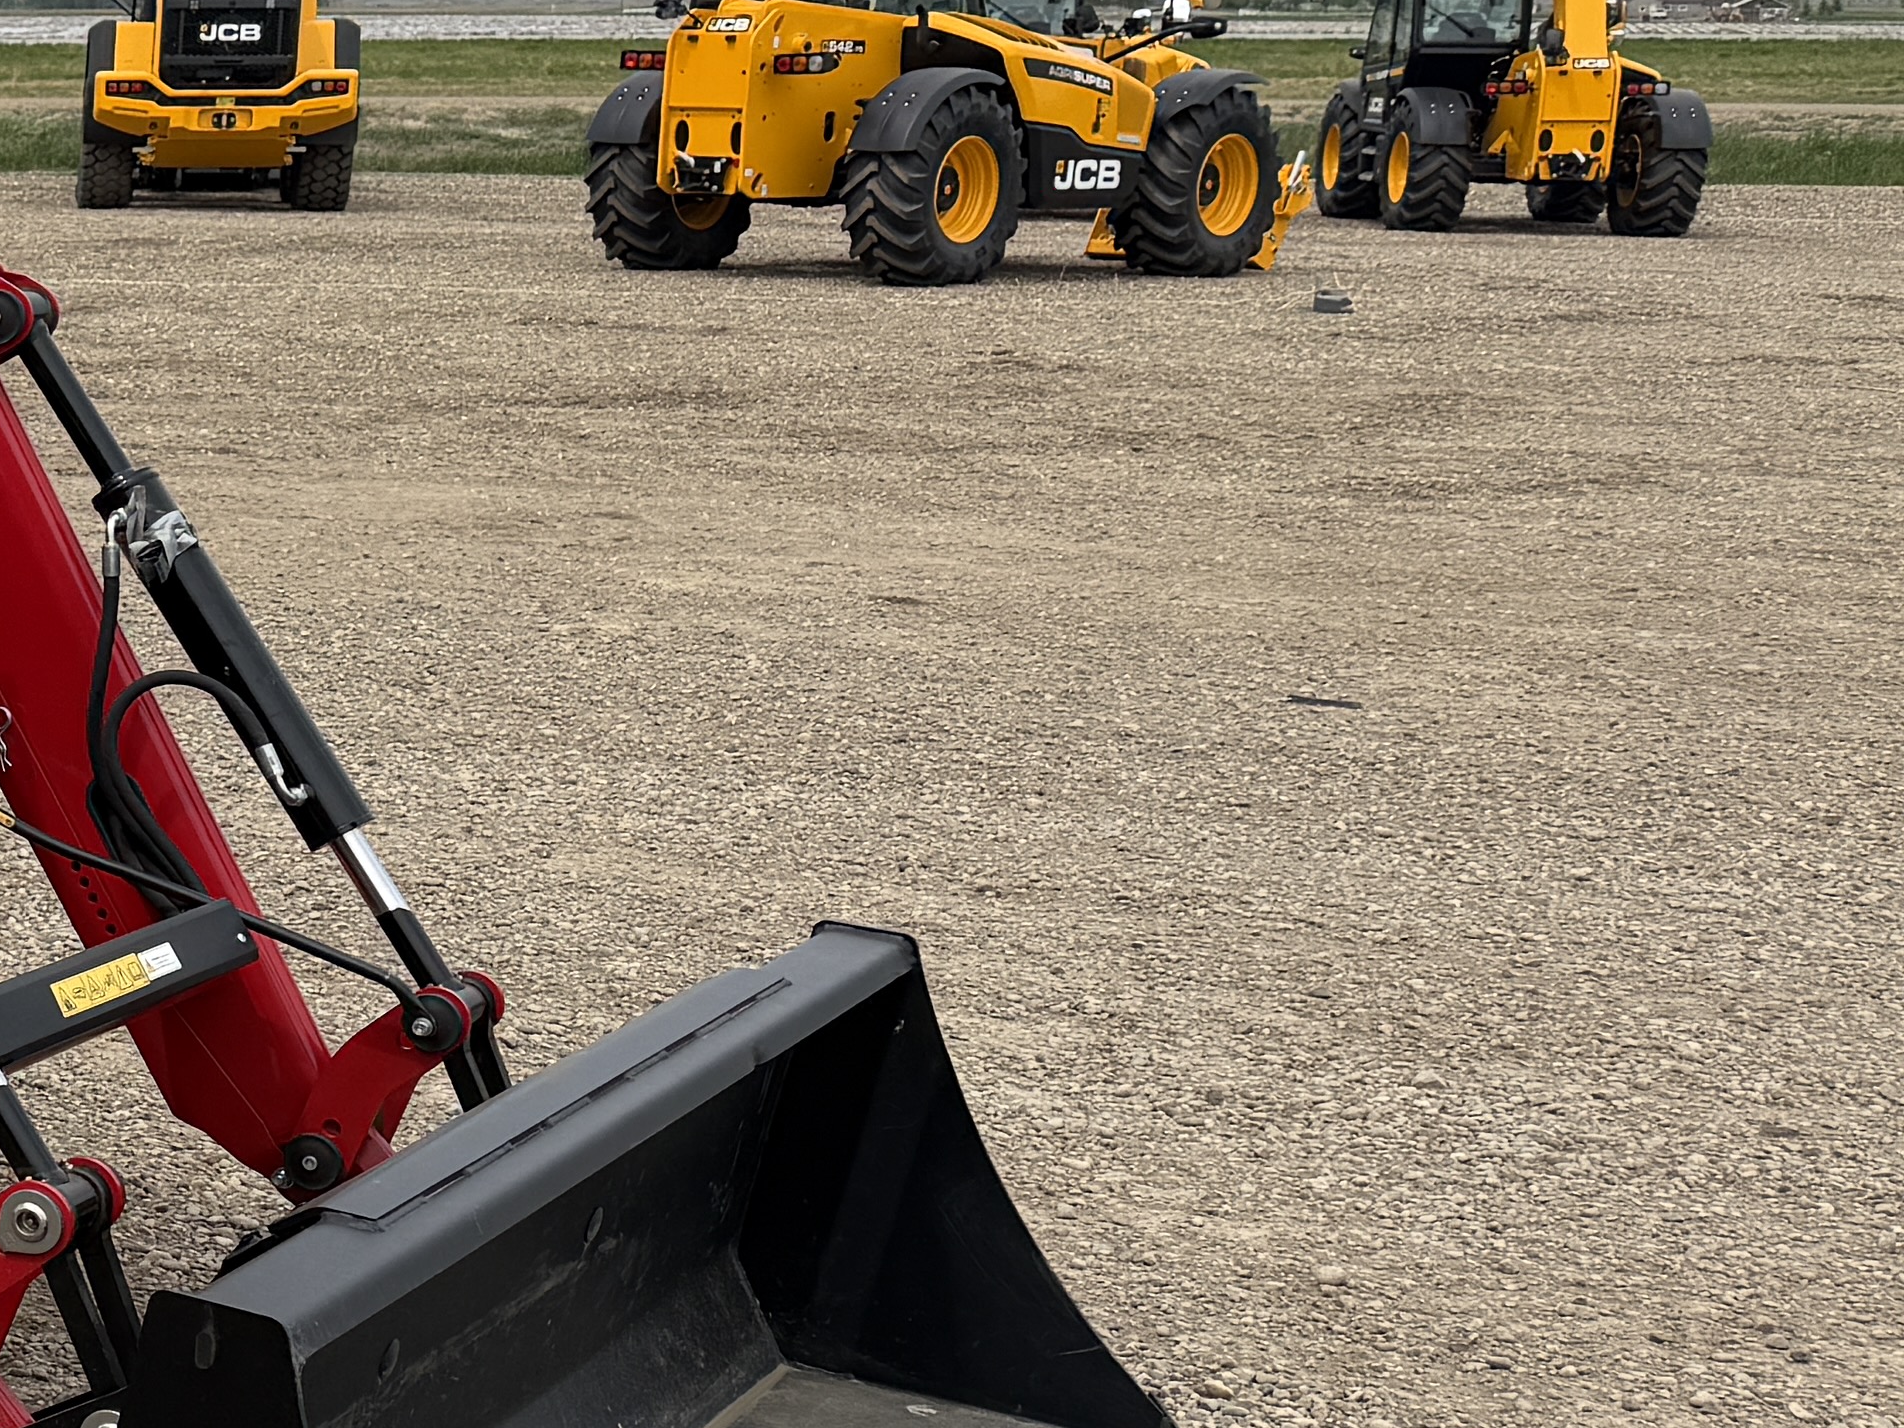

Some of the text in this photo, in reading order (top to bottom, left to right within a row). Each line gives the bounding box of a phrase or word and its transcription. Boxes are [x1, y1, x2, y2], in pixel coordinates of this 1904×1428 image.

[199, 23, 262, 42] JCB
[708, 18, 751, 32] JCB
[1054, 159, 1122, 190] JCB
